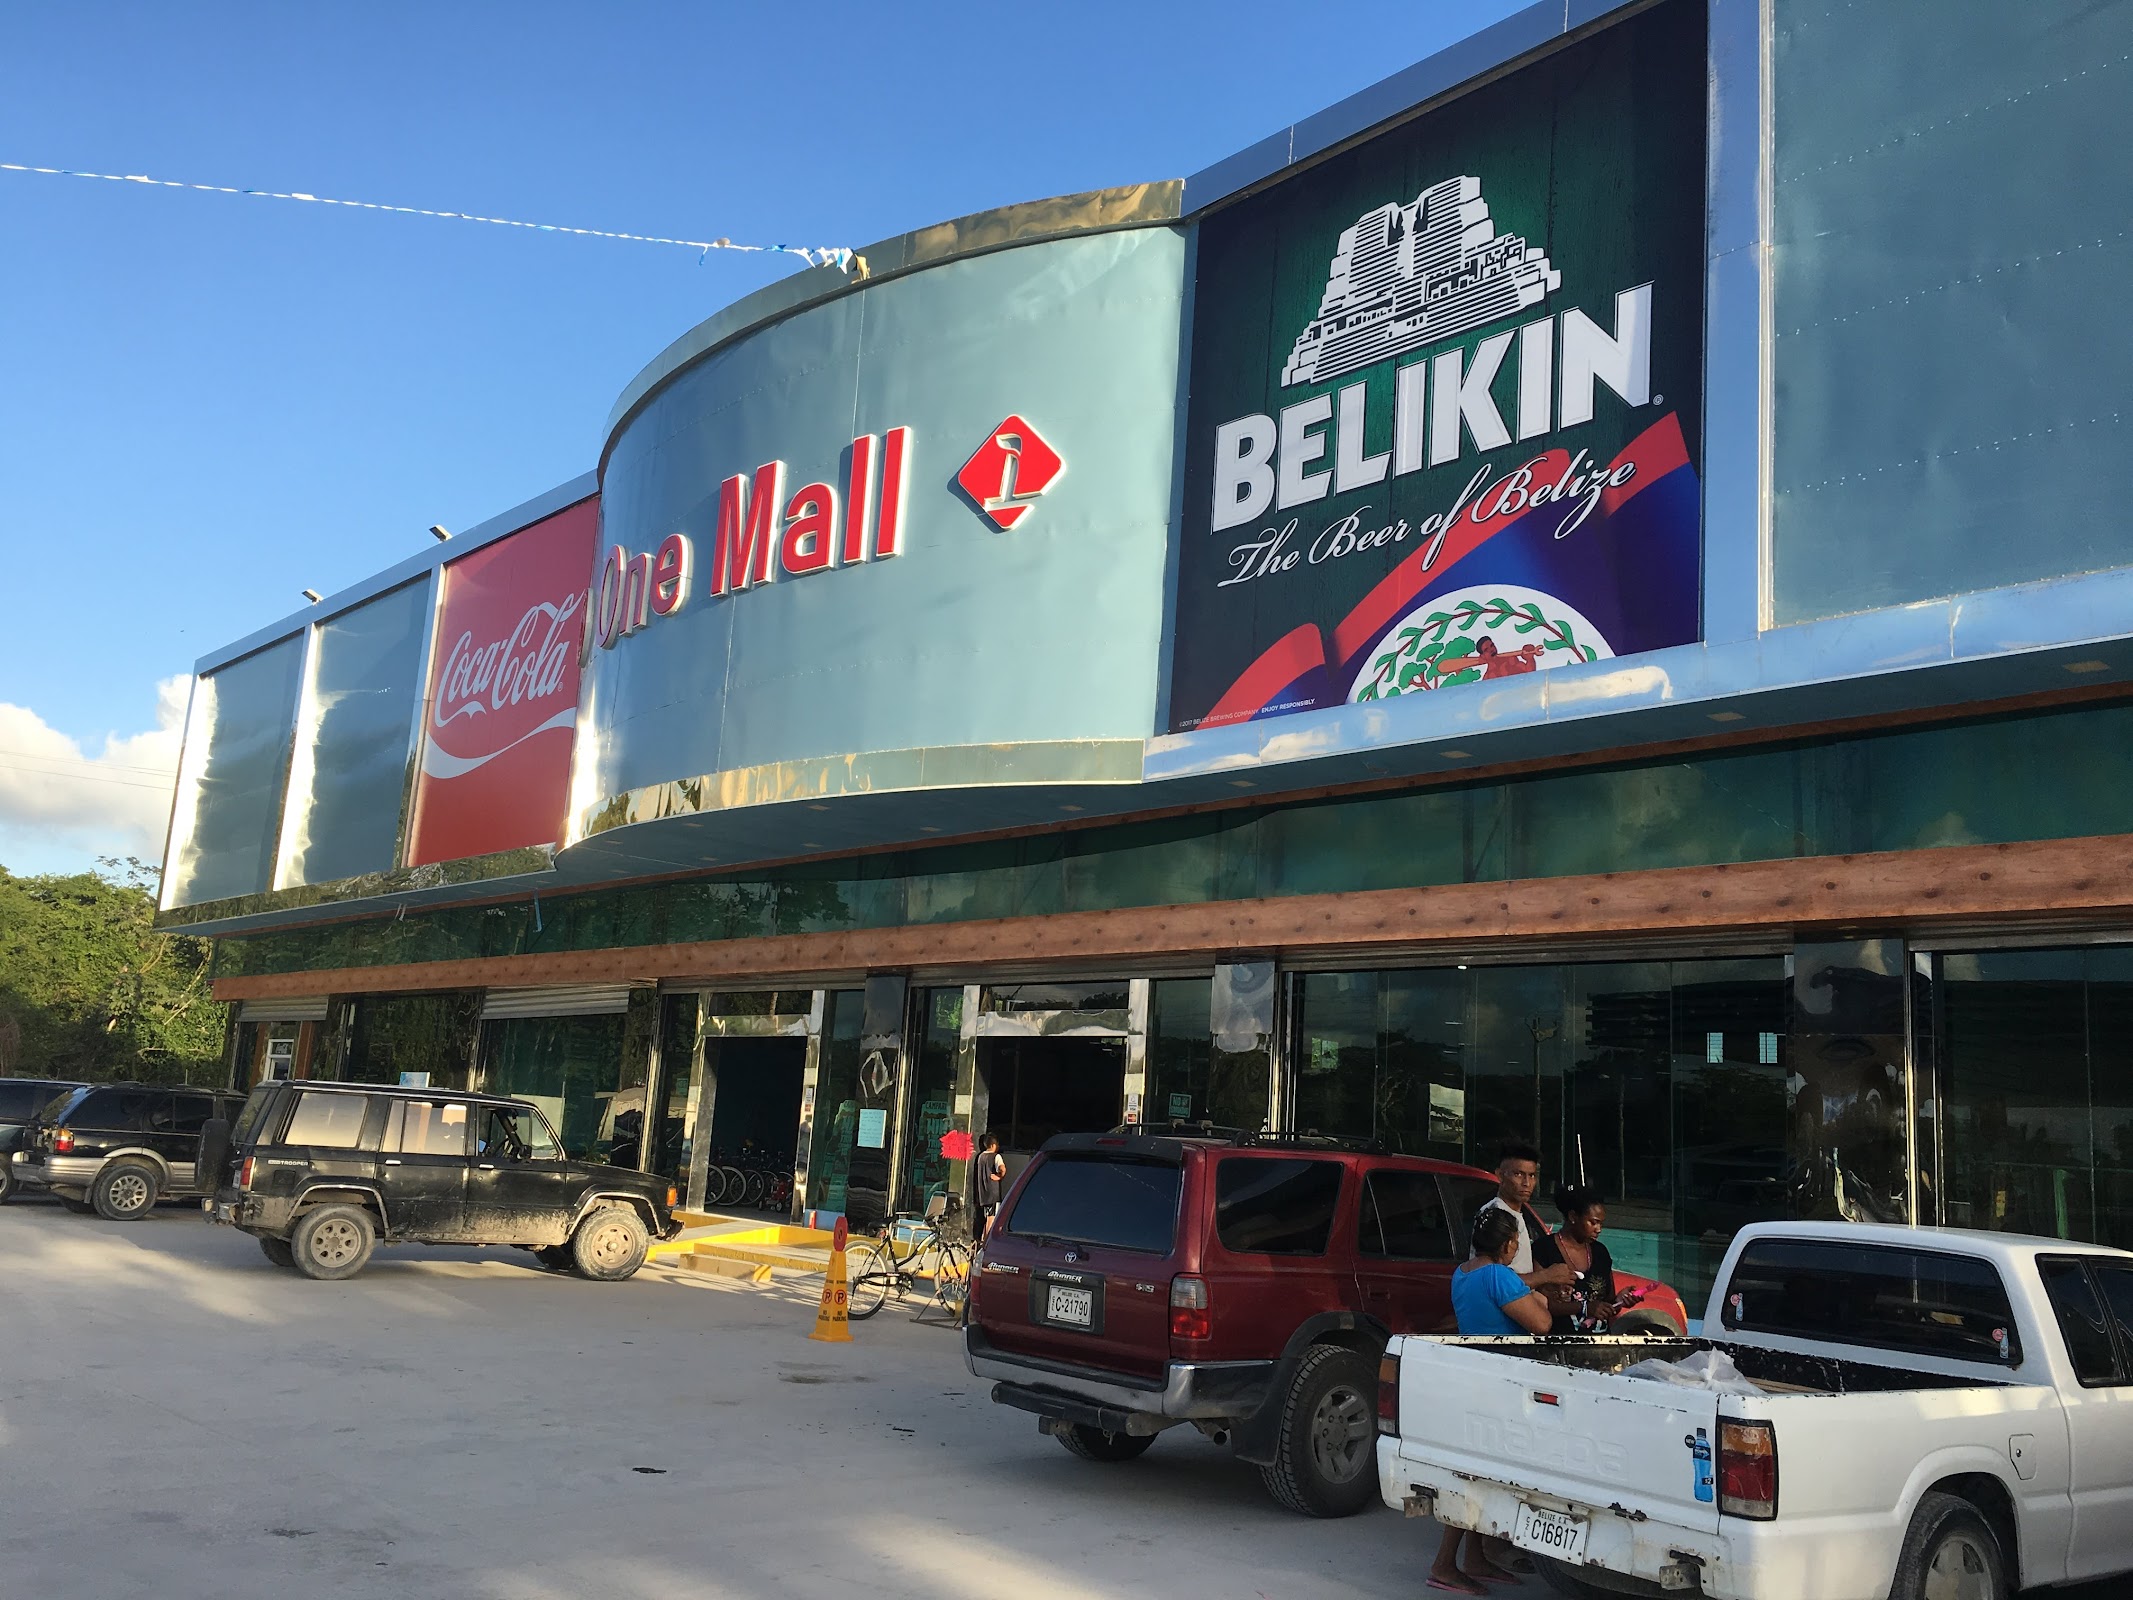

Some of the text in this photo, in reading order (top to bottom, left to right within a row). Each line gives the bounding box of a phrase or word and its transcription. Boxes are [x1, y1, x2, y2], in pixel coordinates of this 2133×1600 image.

[1210, 279, 1655, 536] BELIKIN
[1217, 447, 1637, 588] The Beer of Belize
[597, 425, 914, 651] One Mall
[434, 588, 585, 728] Coca-Cola
[1193, 716, 1210, 725] BELIZE
[1210, 712, 1234, 722] BREWING
[1233, 708, 1259, 719] COMPANY
[1261, 704, 1278, 714] ENJOY
[1055, 1296, 1089, 1317] C-21790
[1538, 1510, 1556, 1522] BELIZE
[1531, 1518, 1578, 1551] C16817
